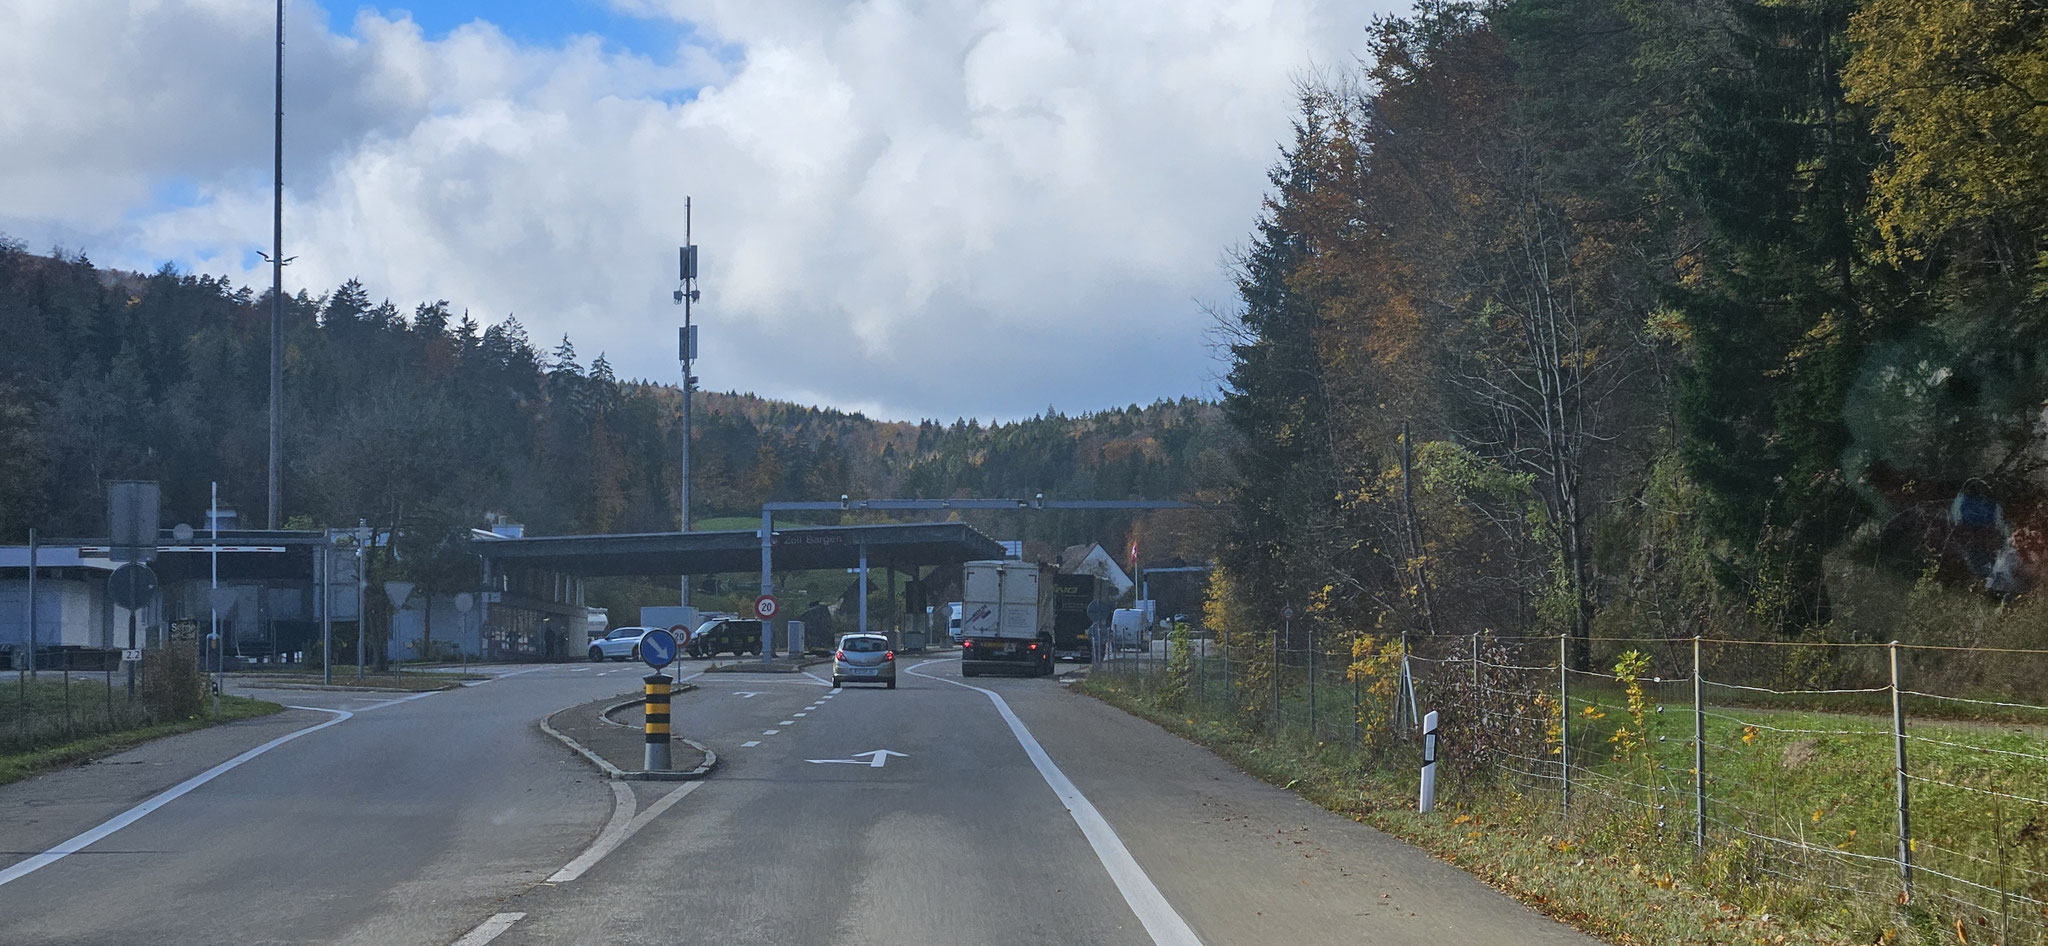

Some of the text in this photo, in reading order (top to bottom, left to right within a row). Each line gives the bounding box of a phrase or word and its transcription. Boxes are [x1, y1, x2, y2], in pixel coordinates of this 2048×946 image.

[761, 603, 773, 612] 20
[674, 632, 685, 641] 20
[126, 651, 140, 659] 2.2
